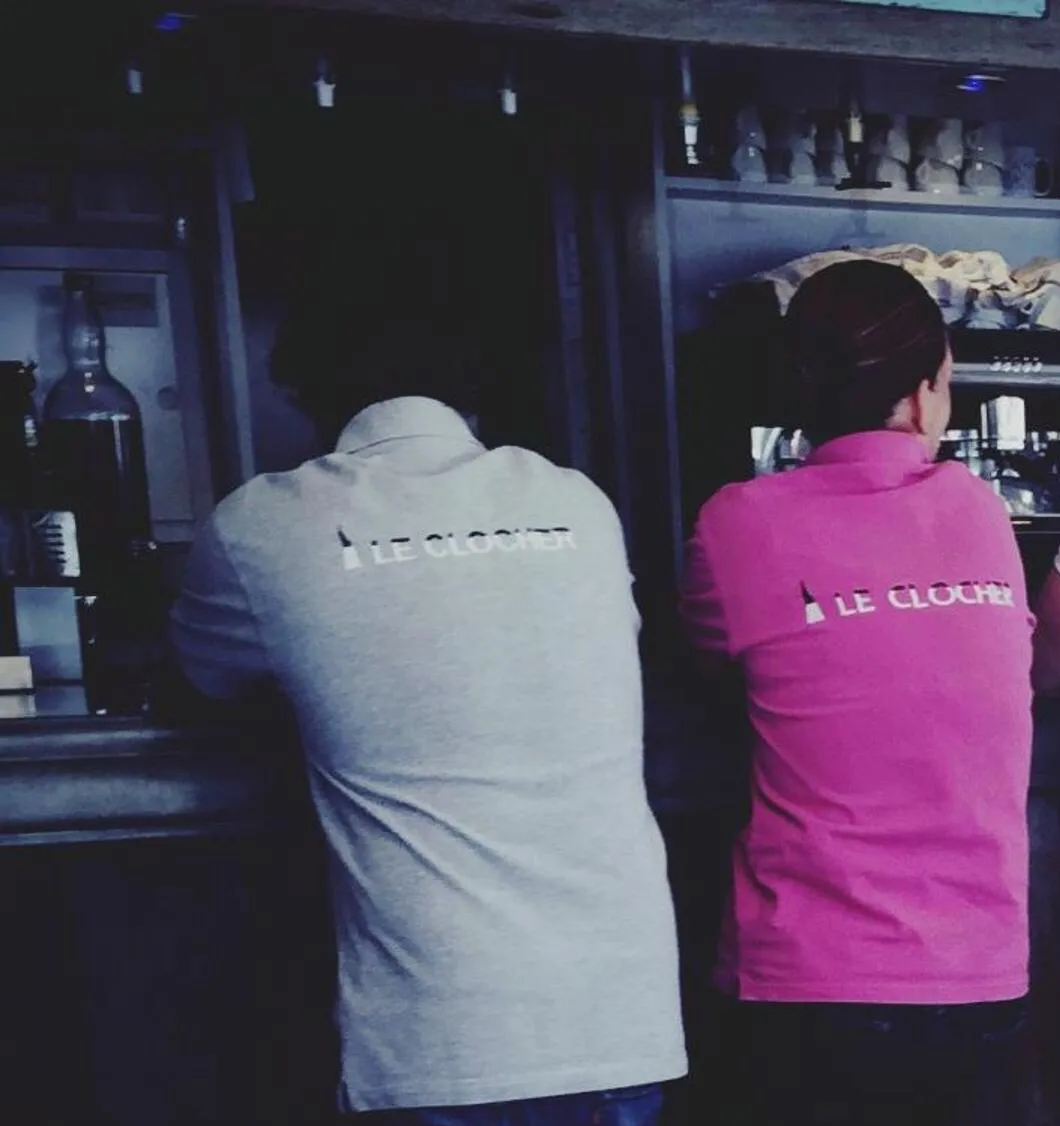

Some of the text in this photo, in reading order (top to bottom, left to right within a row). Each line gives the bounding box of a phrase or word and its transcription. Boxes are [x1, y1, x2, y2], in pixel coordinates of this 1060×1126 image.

[371, 527, 578, 565] LE CLOCHER
[834, 588, 876, 616] LE
